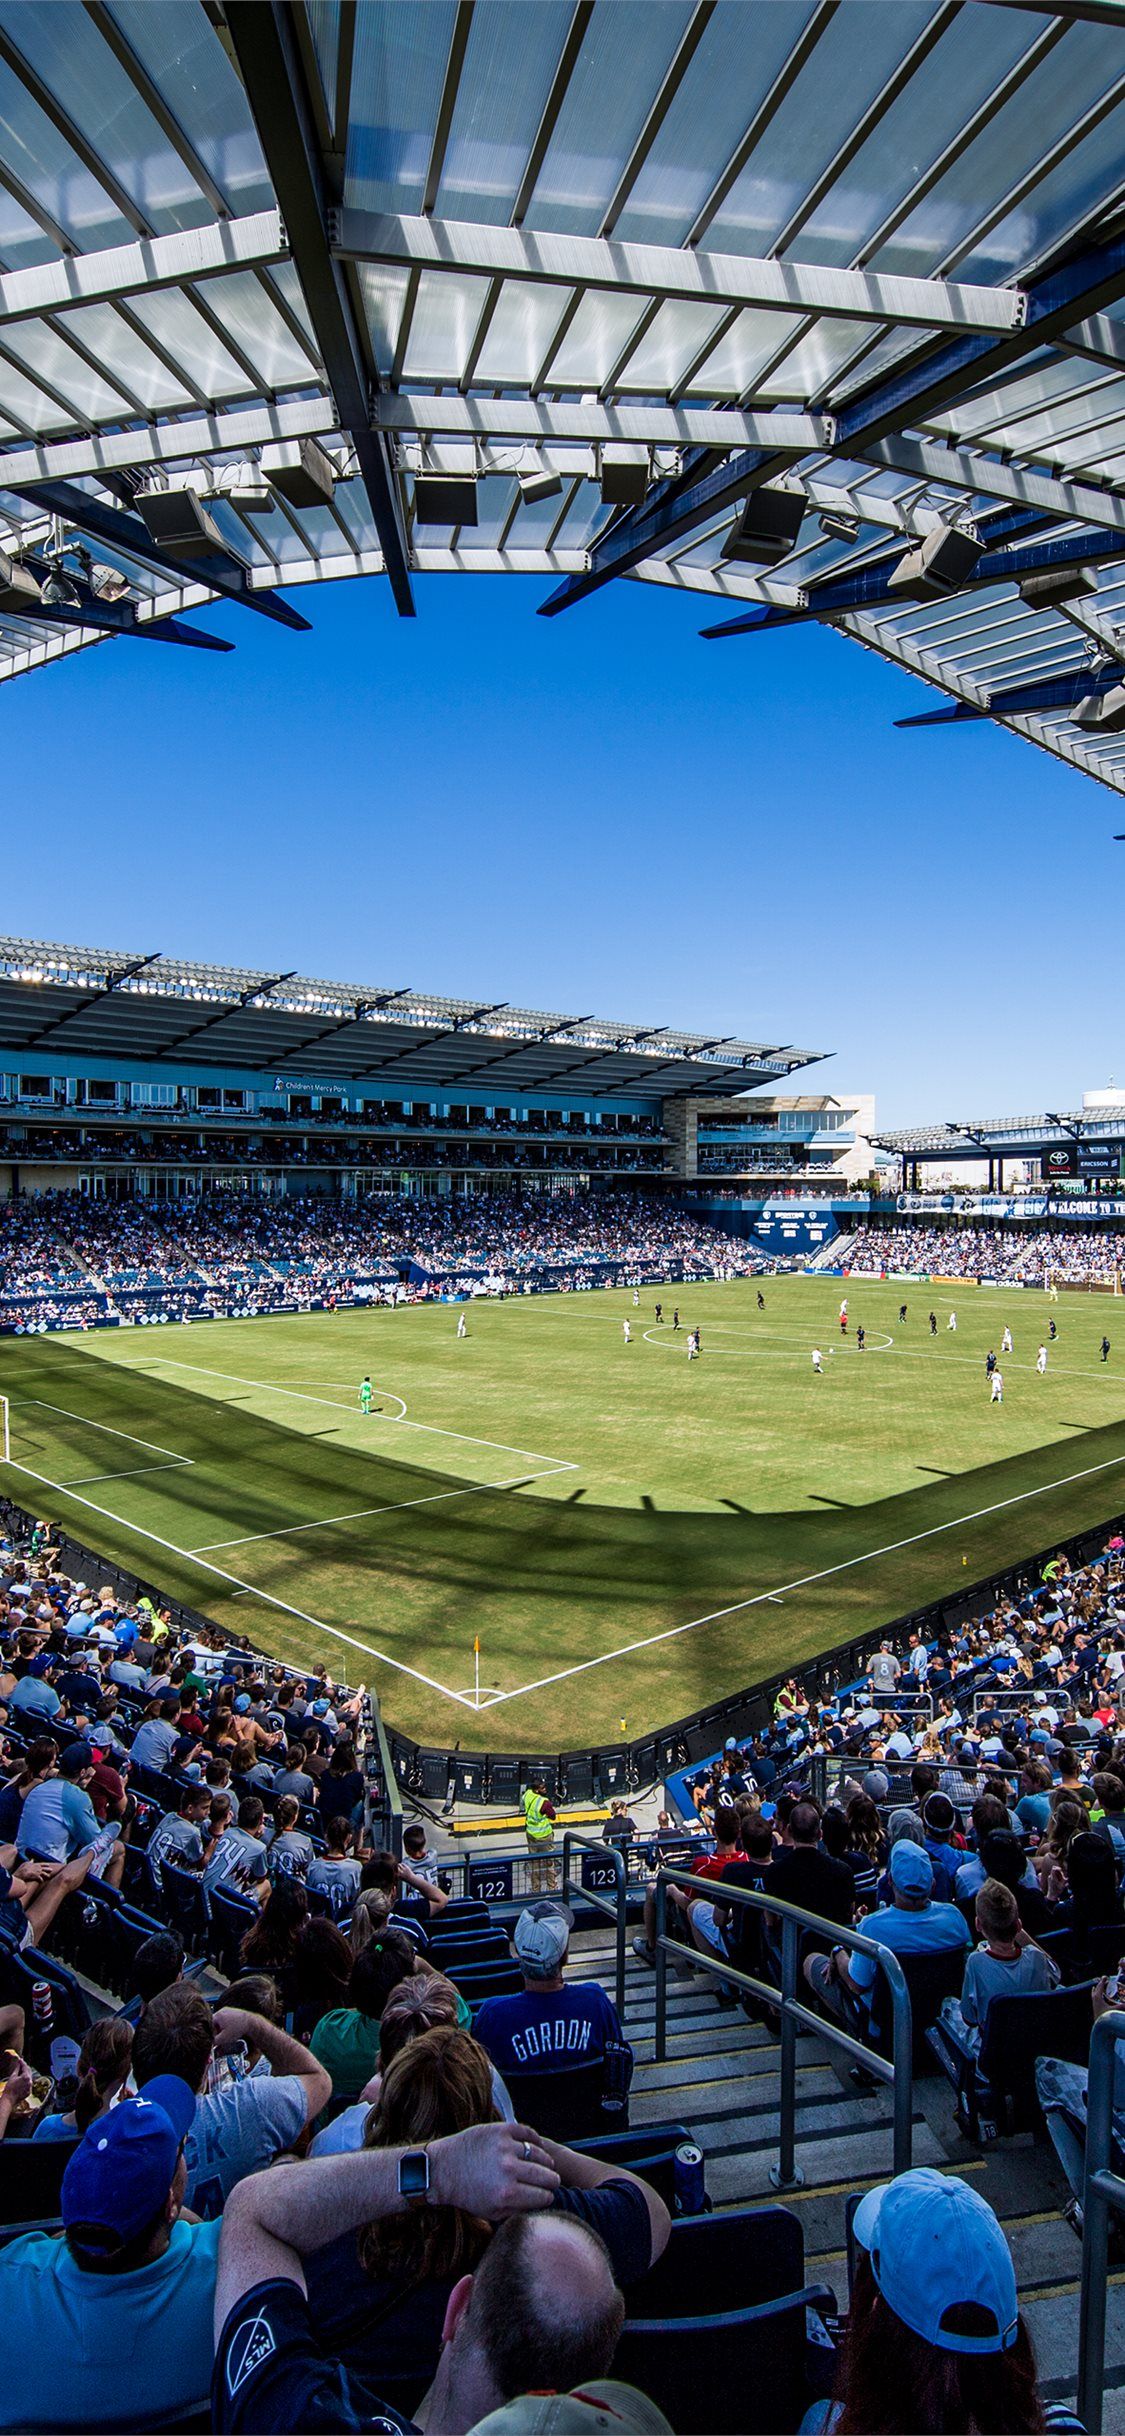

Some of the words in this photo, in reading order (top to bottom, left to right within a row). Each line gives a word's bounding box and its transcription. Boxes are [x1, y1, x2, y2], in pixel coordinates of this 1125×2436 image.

[315, 1084, 333, 1093] Mercy
[333, 1085, 347, 1093] Park
[1048, 1200, 1098, 1214] WELCOME
[1100, 1203, 1111, 1214] TO
[997, 1280, 1024, 1288] adidas
[881, 1663, 889, 1676] 8
[590, 1868, 616, 1886] 123
[477, 1881, 506, 1898] 122
[511, 2019, 592, 2062] GORDON
[244, 2338, 271, 2371] MLS
